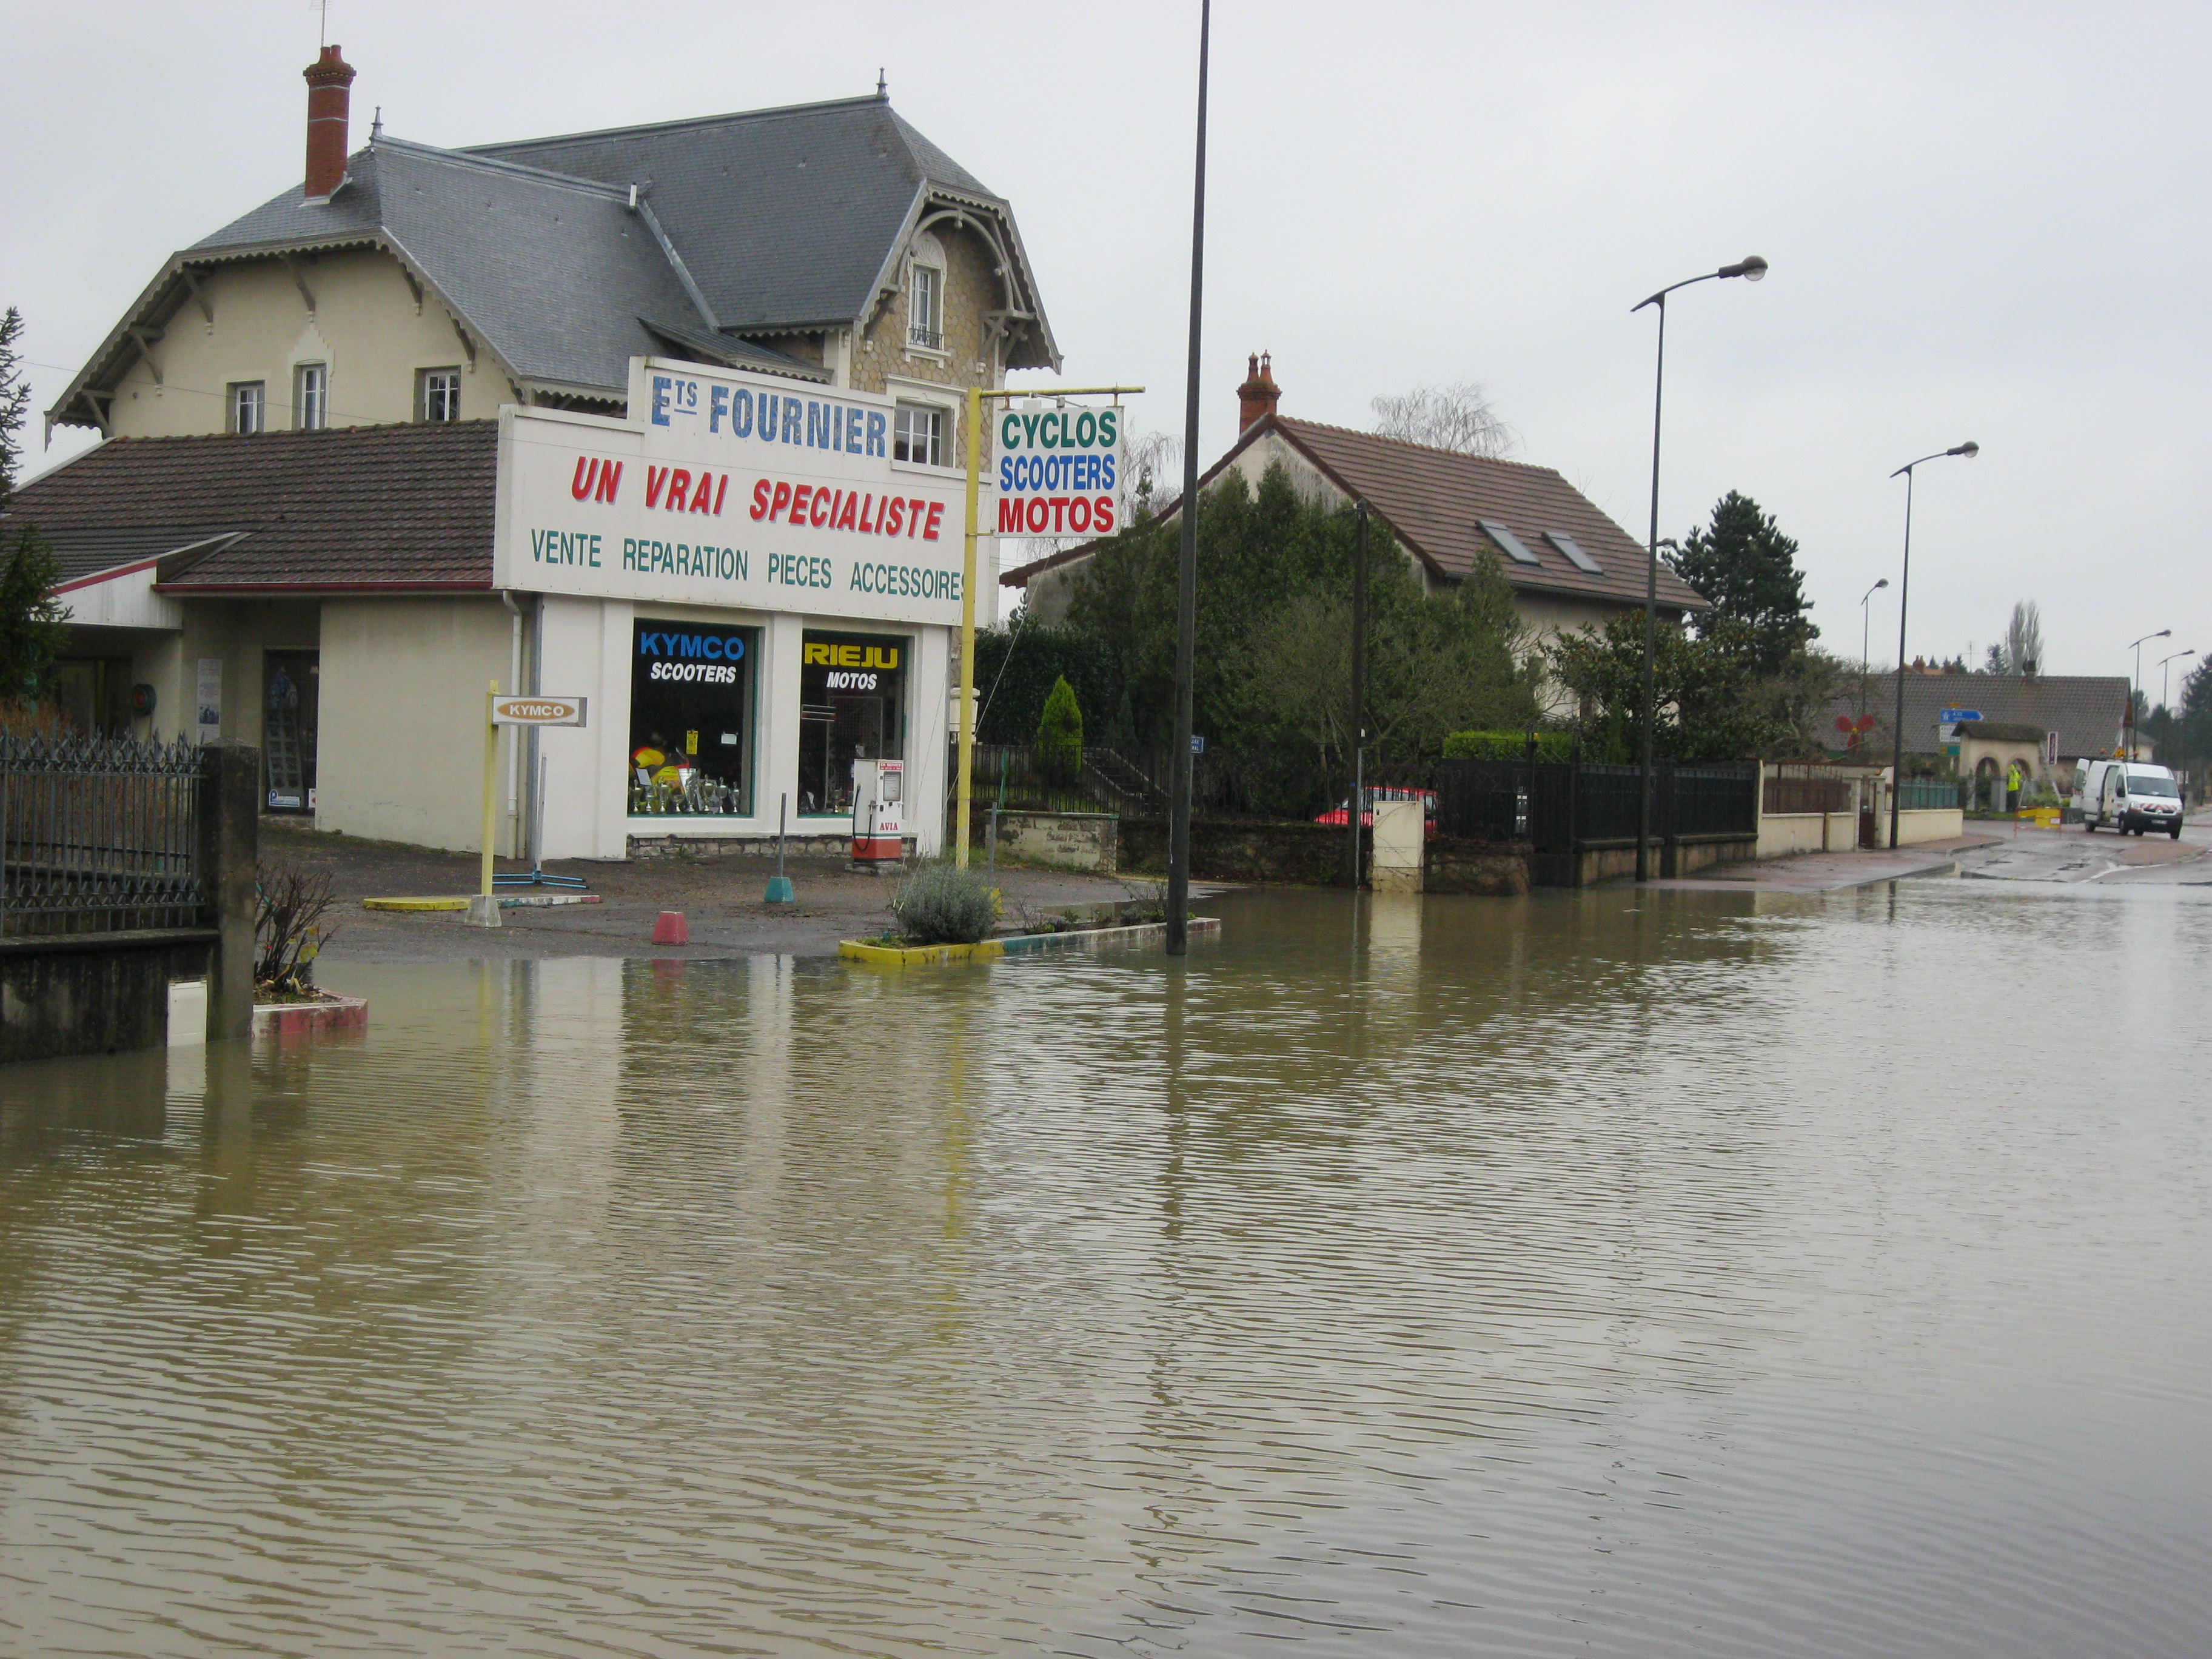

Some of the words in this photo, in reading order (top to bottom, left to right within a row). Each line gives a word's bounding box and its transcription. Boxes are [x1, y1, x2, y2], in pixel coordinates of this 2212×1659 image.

[709, 384, 886, 458] FOURNIER
[1001, 411, 1116, 449] CYCLOS
[999, 453, 1116, 492] SCOOTERS
[571, 456, 623, 505] UN
[645, 464, 729, 517] VRAI
[749, 478, 946, 542] SPECIALISTE
[997, 495, 1114, 533] MOTOS
[531, 528, 602, 568] VENTE
[623, 538, 748, 581] REPARATION
[768, 552, 832, 589] PIECES
[640, 632, 745, 660] KYMCO
[804, 643, 898, 669] RIEJU
[650, 662, 737, 683] SCOOTERS
[826, 671, 877, 690] MOTOS
[509, 705, 565, 716] KYMCO
[879, 822, 899, 831] AVIA
